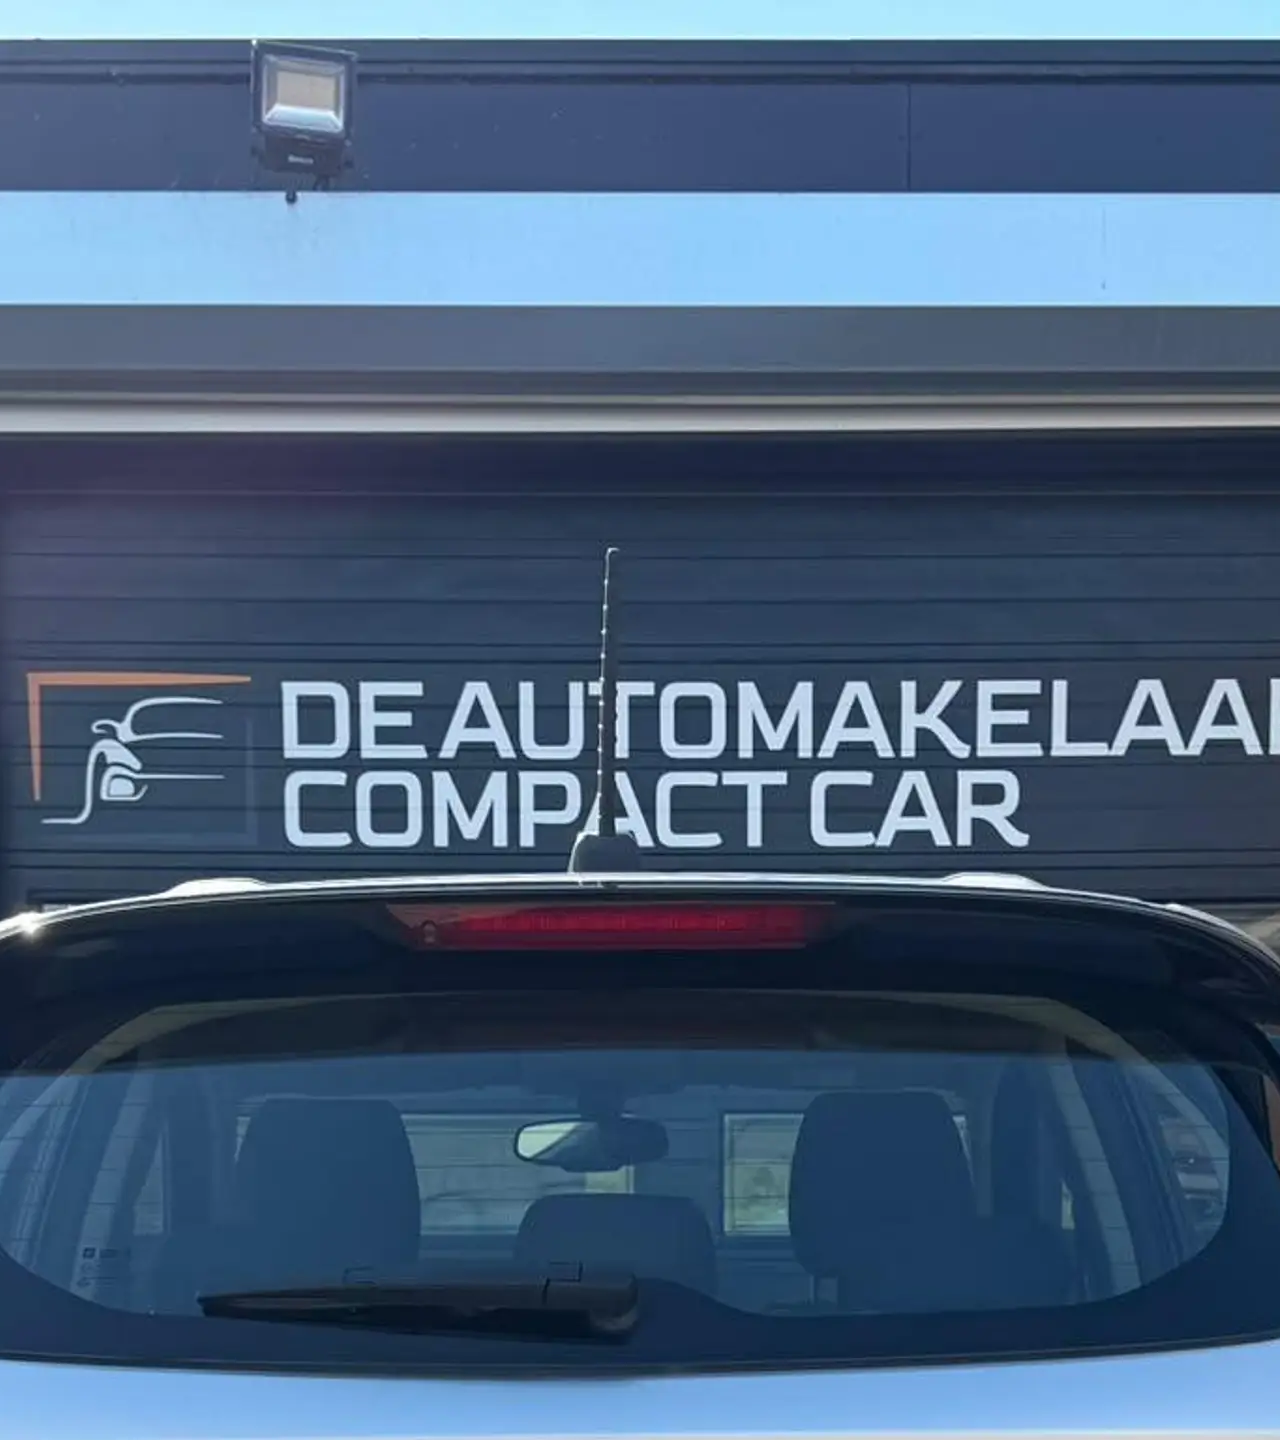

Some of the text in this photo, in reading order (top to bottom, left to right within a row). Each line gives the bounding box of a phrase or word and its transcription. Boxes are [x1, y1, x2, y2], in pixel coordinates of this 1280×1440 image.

[281, 681, 428, 759] DE
[284, 769, 1030, 847] COMPACT CAR
